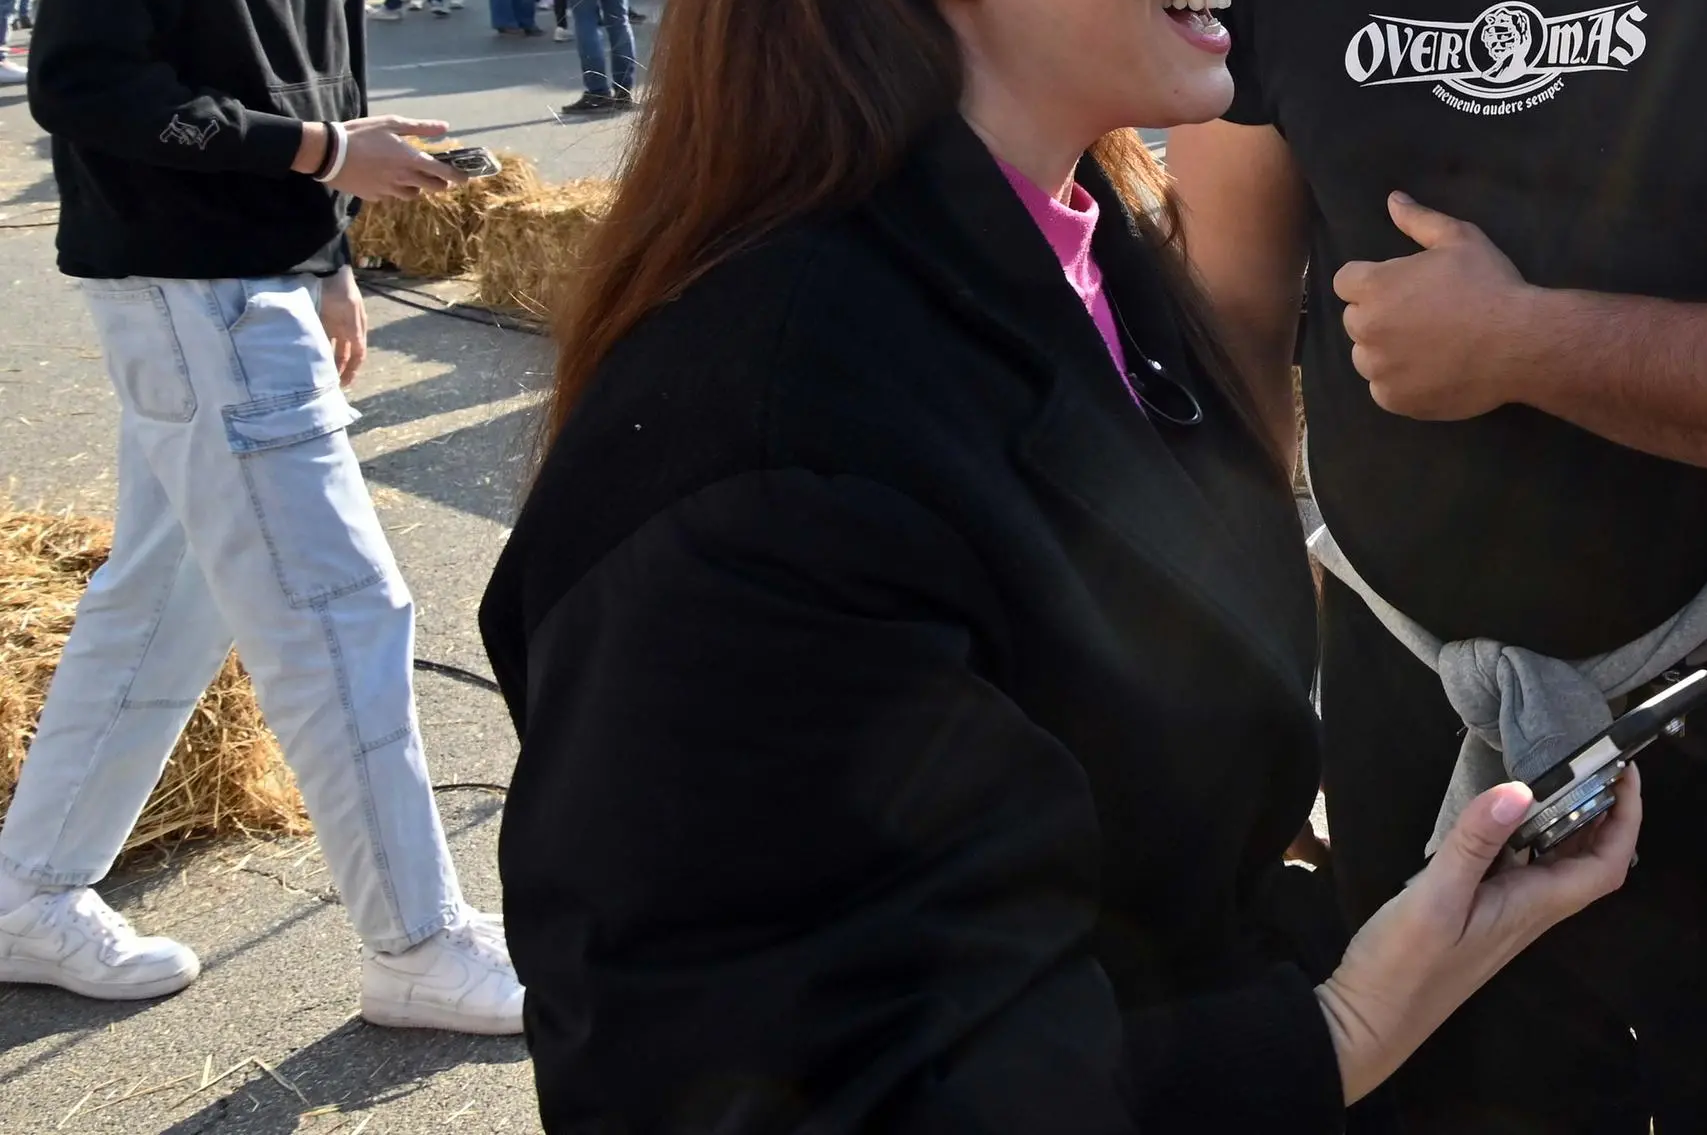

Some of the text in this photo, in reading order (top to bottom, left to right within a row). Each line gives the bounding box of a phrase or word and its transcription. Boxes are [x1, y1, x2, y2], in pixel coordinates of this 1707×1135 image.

[1344, 5, 1648, 83] OVER MAS
[1482, 100, 1524, 116] audere
[1525, 77, 1565, 109] semper
